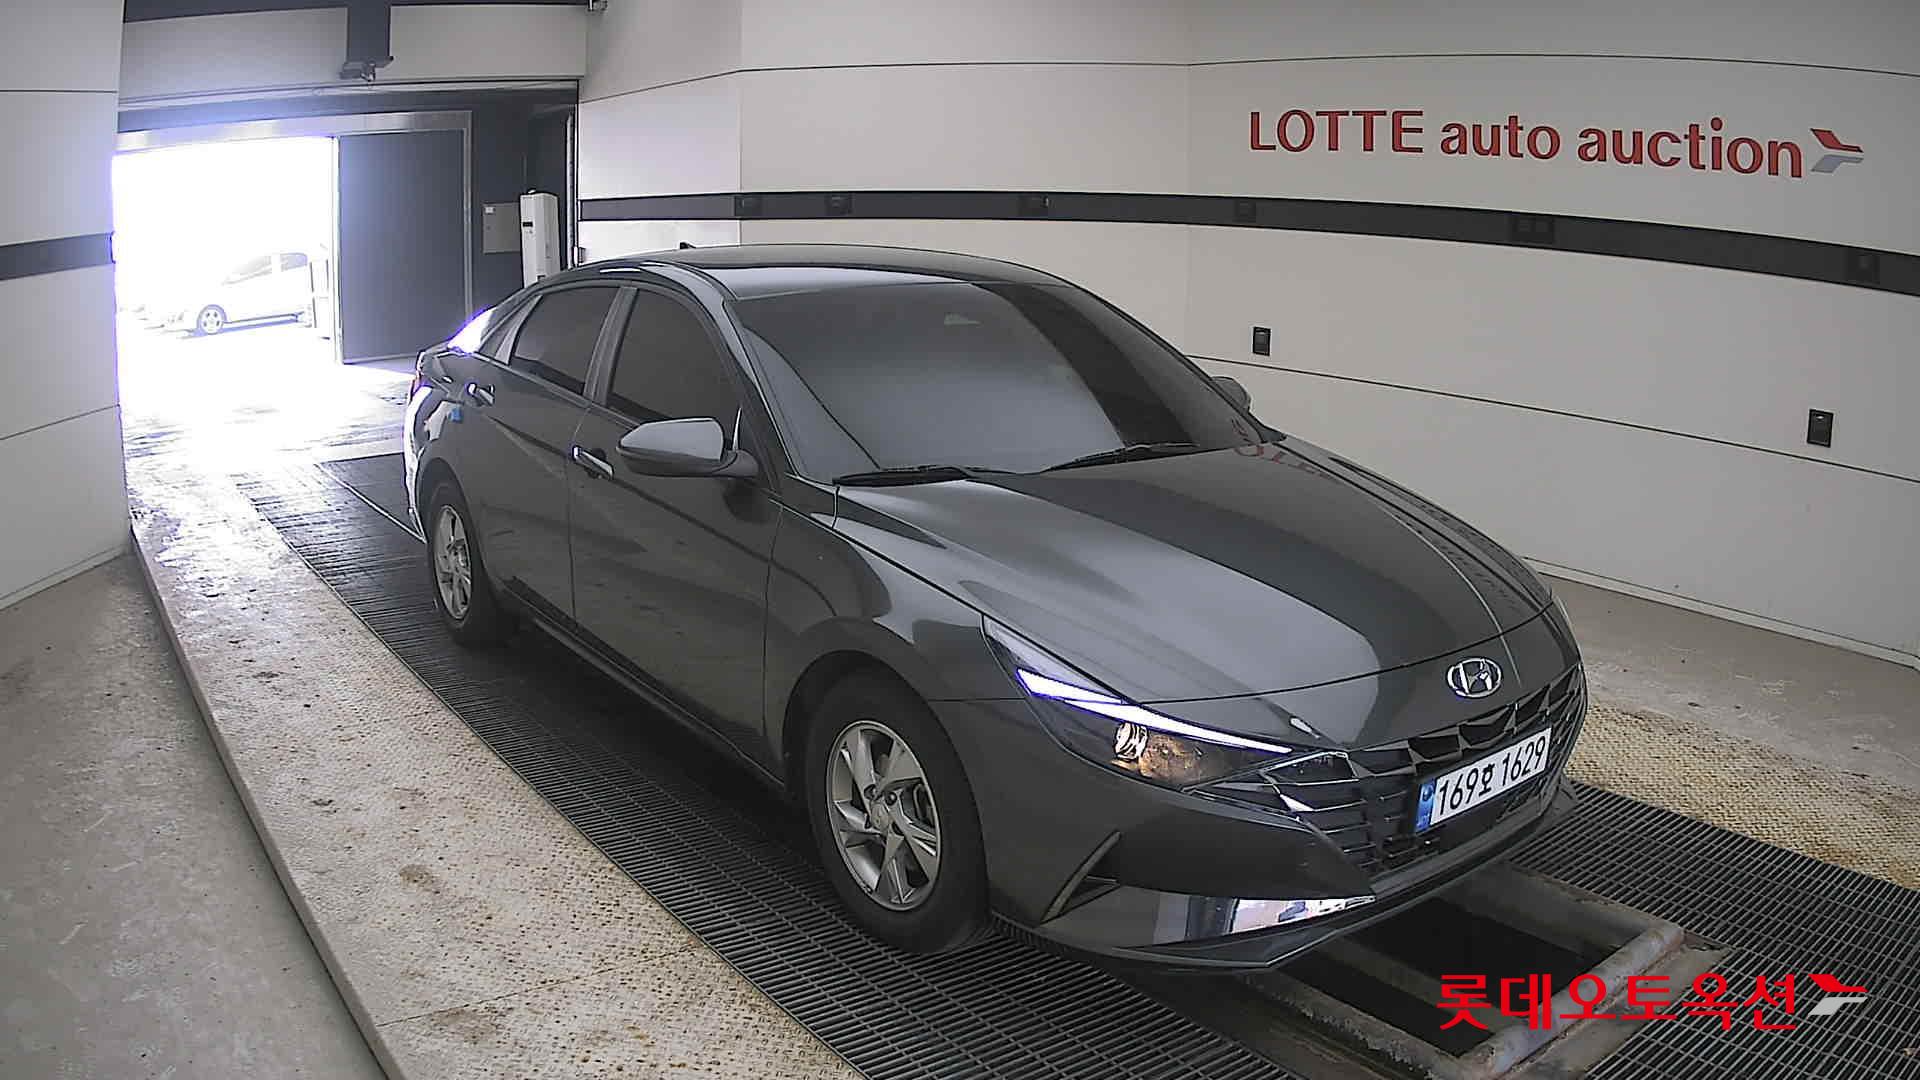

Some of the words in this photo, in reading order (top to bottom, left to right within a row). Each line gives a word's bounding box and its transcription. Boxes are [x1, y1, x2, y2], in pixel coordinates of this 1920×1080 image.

[1250, 110, 1424, 154] LOTTE
[1440, 116, 1561, 159] auto
[1577, 117, 1804, 178] auction
[1438, 762, 1496, 816] 169호
[1502, 735, 1547, 787] 1629
